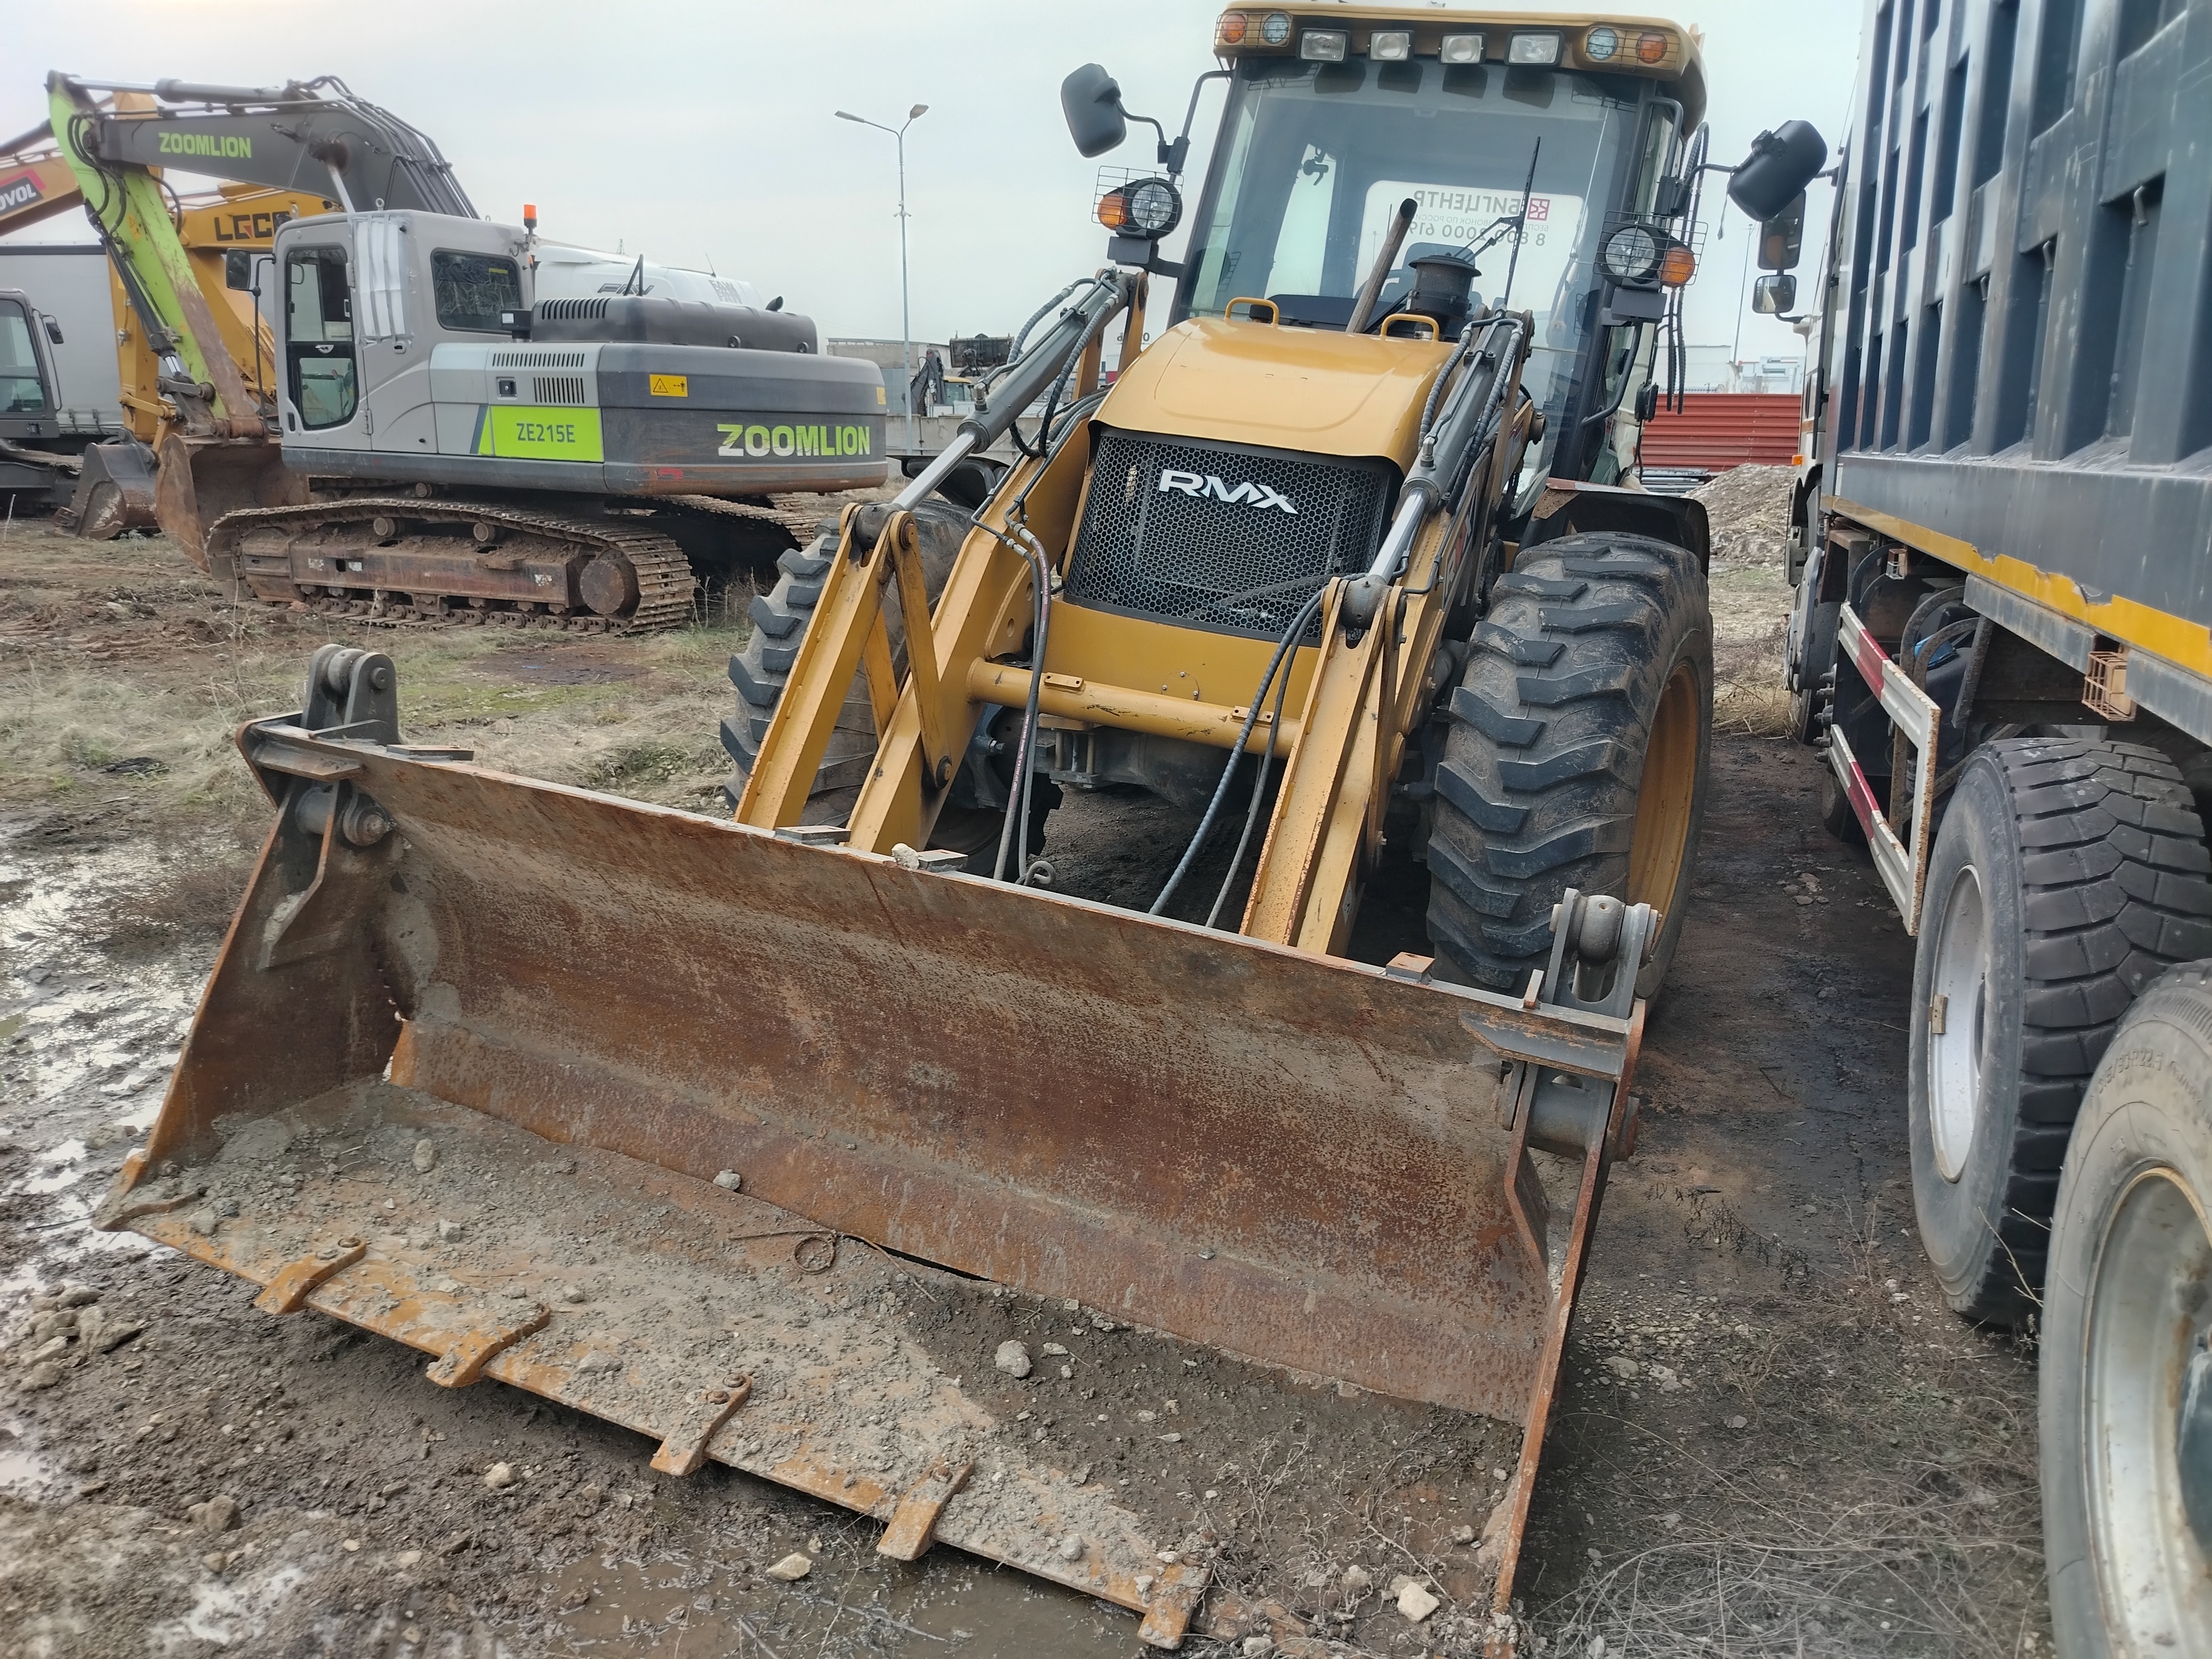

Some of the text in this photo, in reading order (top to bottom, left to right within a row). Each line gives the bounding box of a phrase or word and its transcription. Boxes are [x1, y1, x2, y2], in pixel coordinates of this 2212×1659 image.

[159, 132, 252, 158] ZOOMLION
[517, 423, 575, 443] ZE215E
[717, 424, 870, 457] ZOOMLION
[1159, 469, 1299, 514] RMX
